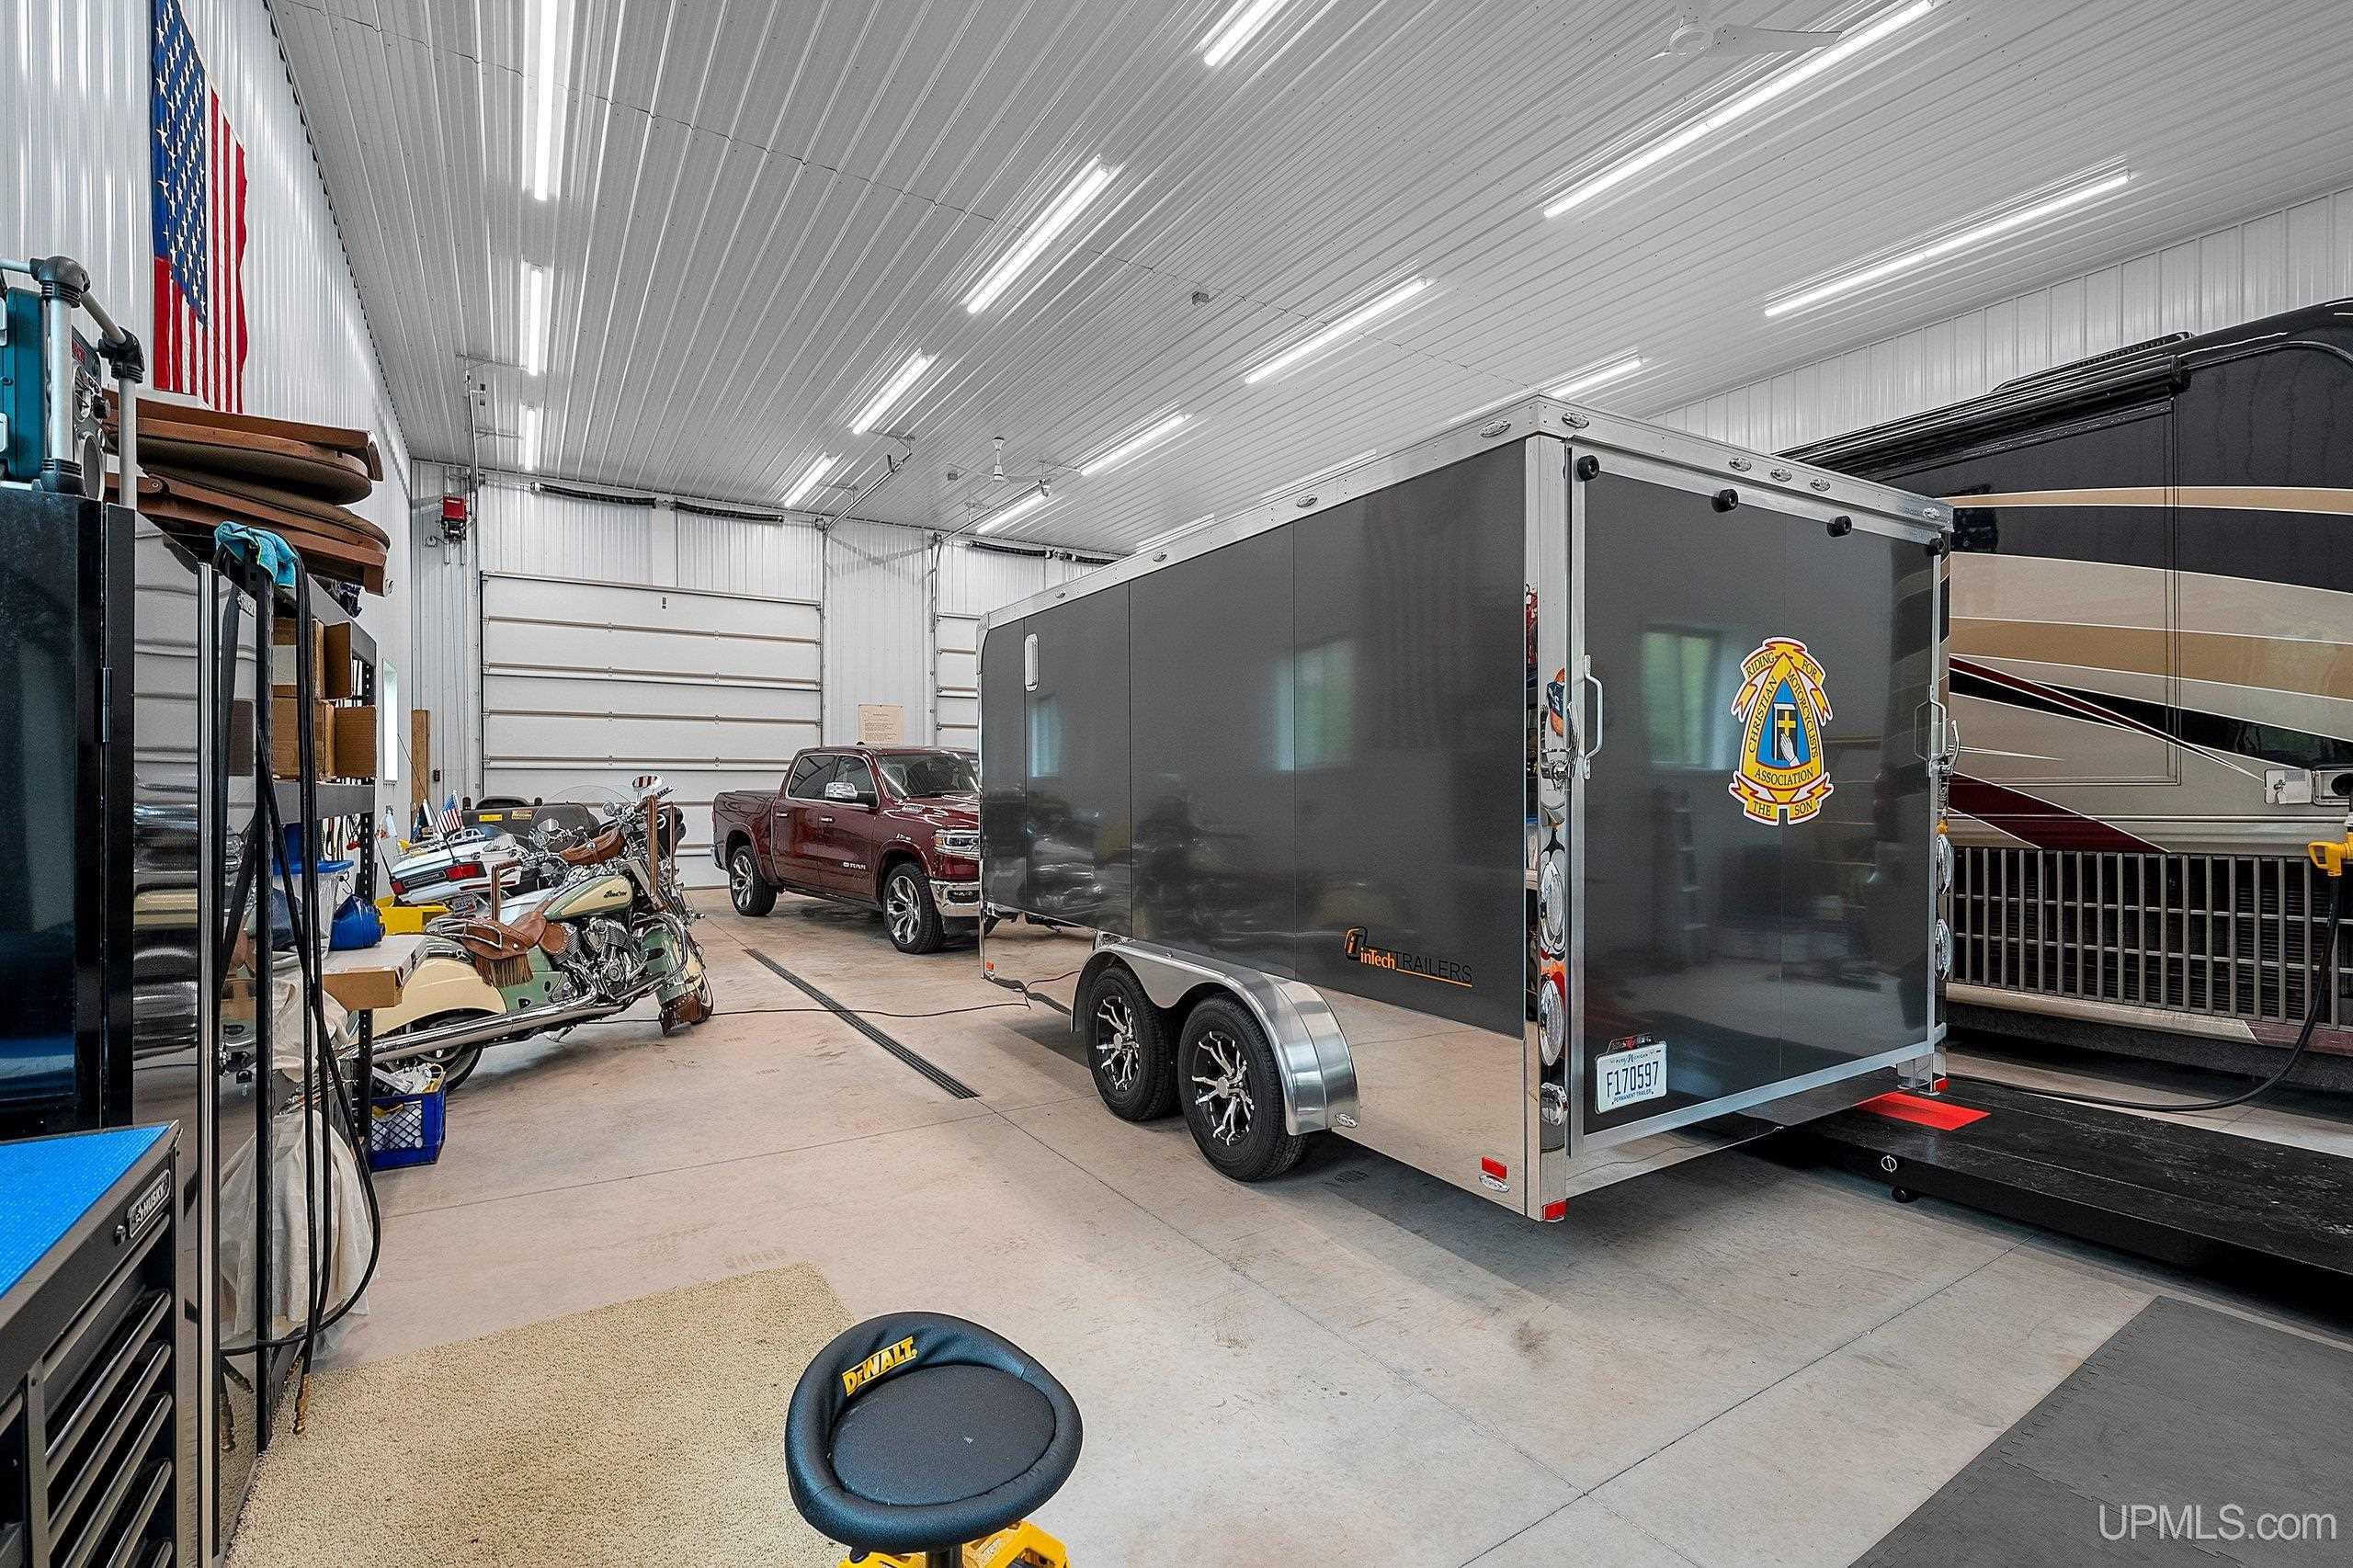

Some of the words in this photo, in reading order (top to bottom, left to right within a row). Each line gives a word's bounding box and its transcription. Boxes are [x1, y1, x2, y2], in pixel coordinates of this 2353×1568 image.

[1745, 652, 1776, 677] RIDING
[1801, 659, 1818, 679] FOR
[1749, 675, 1778, 754] CHRISTIAN
[1786, 670, 1819, 758] MOTORCYCLISTS
[1755, 767, 1814, 787] ASSOCIATION
[1752, 801, 1771, 816] THE
[1794, 799, 1813, 816] SON
[1360, 948, 1396, 970] inTech
[1395, 950, 1472, 982] TRAILERS
[1607, 1061, 1659, 1098] F170597
